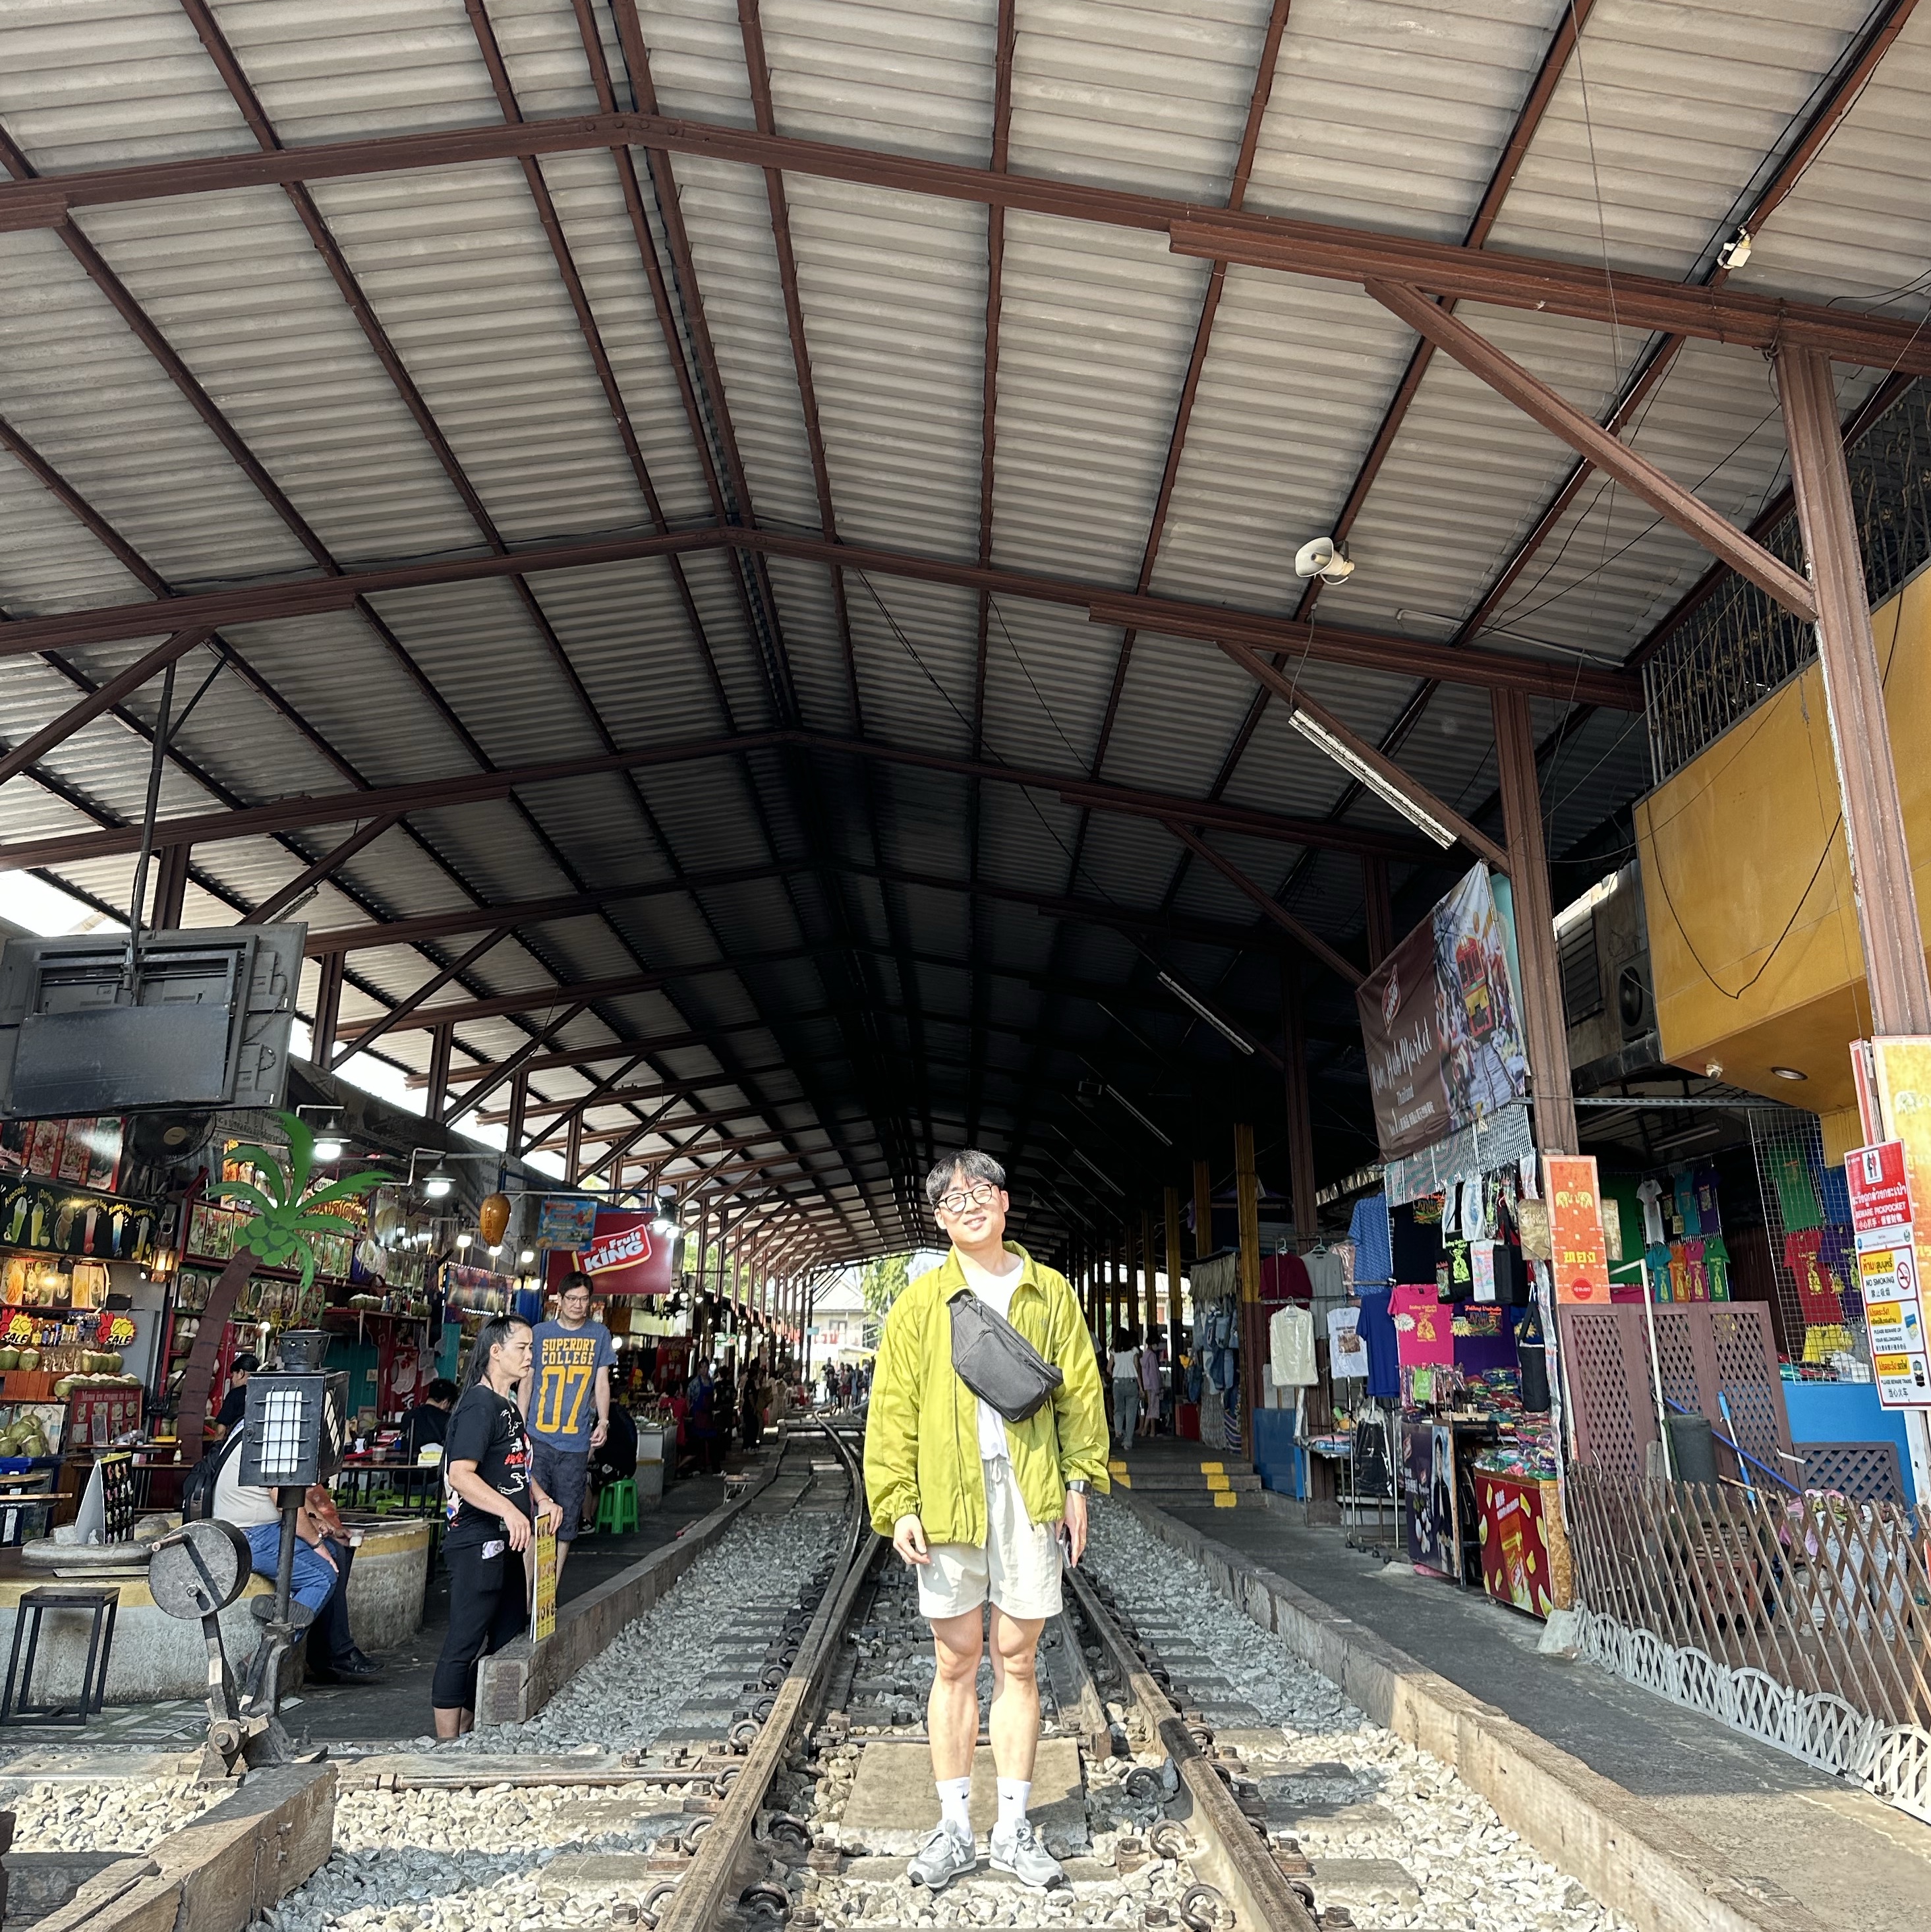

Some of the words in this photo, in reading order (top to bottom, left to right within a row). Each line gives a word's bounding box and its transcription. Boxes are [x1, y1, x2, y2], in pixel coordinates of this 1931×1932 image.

[1385, 1039, 1401, 1090] Hub
[1399, 1015, 1432, 1077] Market
[5, 1184, 27, 1209] Avocado
[1855, 1207, 1874, 1220] BEWARE
[1874, 1201, 1906, 1216] PICKPOCKET
[609, 1231, 641, 1249] Fruit
[584, 1240, 645, 1272] KING
[1873, 1276, 1895, 1286] SMOKING
[11, 1318, 31, 1332] 20
[111, 1321, 132, 1335] 20
[1, 1332, 28, 1344] SALE
[105, 1335, 132, 1345] SALE
[542, 1338, 596, 1352] SUPERDRY
[541, 1351, 595, 1365] COLLEGE
[535, 1365, 592, 1434] 07
